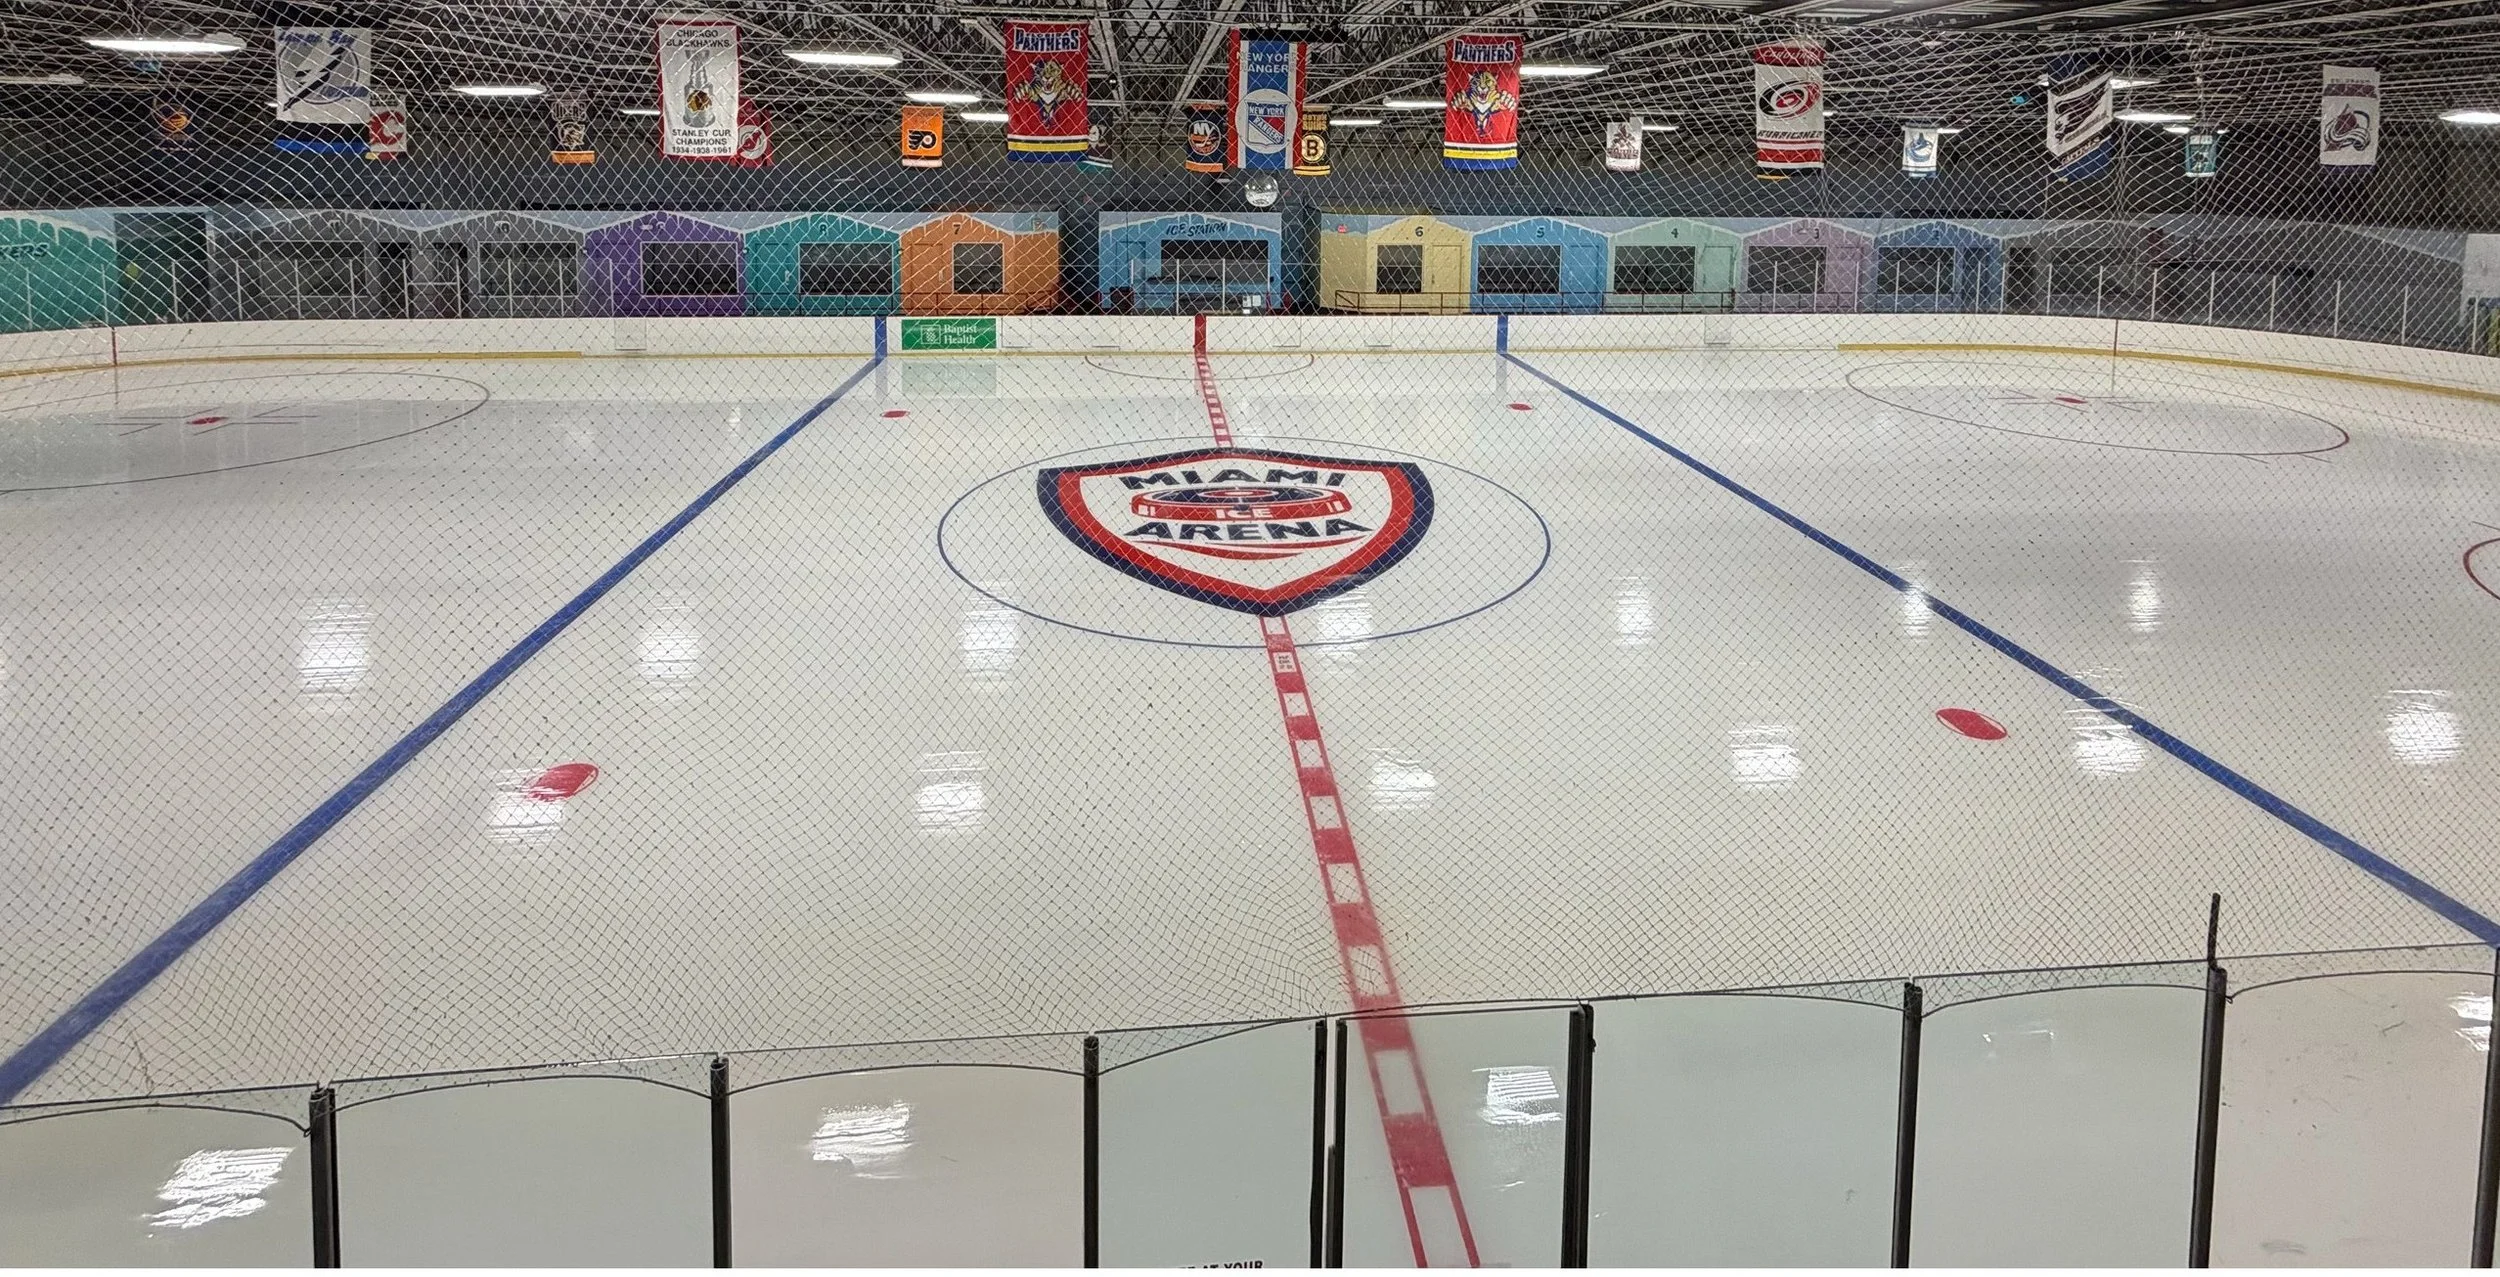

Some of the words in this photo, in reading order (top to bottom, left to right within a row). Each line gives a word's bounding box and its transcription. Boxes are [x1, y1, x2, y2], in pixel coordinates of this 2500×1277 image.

[676, 29, 719, 38] CHICAGO
[1014, 27, 1080, 51] PANTHERS
[1453, 39, 1515, 62] PANTHERS
[953, 224, 961, 235] 7
[1166, 223, 1187, 235] ICE
[1415, 226, 1424, 237] 6
[1536, 227, 1545, 238] 5
[1670, 228, 1679, 239] 4
[944, 324, 977, 336] Baptist
[944, 335, 976, 344] Health
[1119, 469, 1346, 490] MIAMI
[1216, 508, 1274, 519] ICE
[1123, 519, 1374, 540] ARENA
